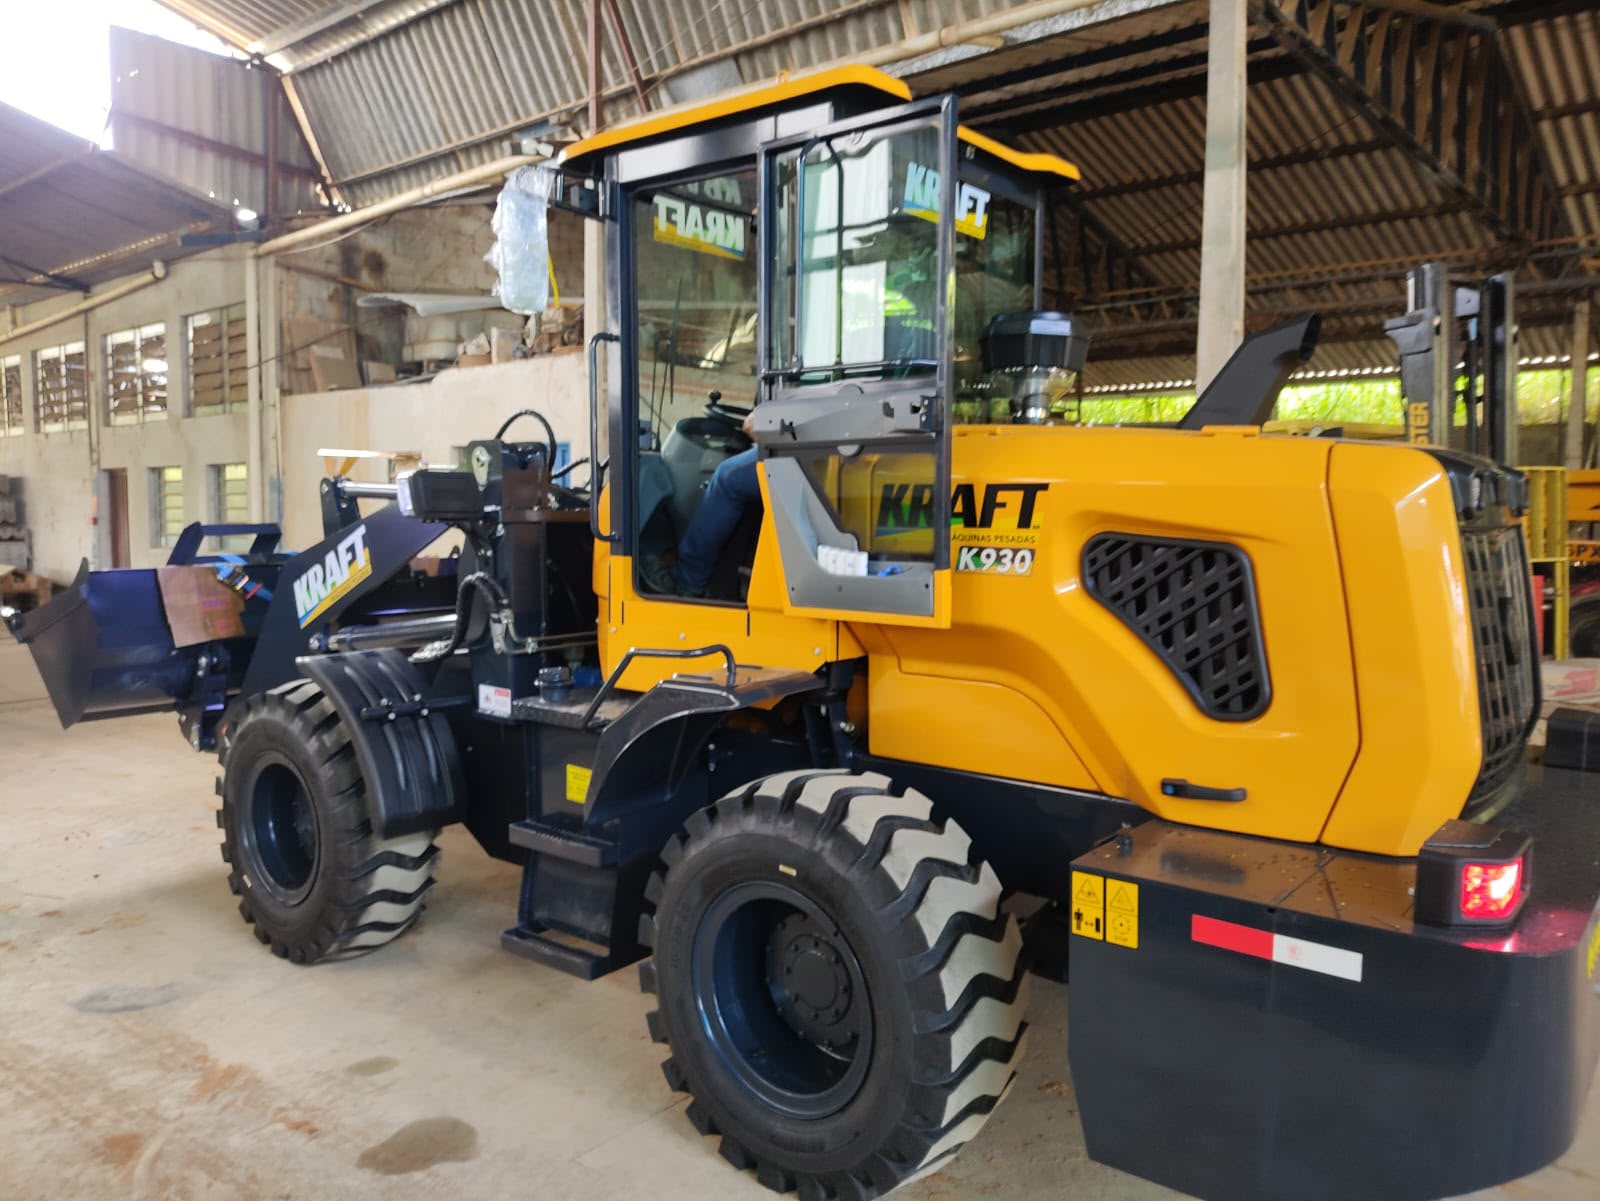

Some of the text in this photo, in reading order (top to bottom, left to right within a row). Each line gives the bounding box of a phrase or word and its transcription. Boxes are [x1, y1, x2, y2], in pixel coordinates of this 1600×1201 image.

[904, 161, 992, 229] KRFT
[1409, 402, 1429, 446] STER
[293, 524, 366, 618] KRAFT
[958, 547, 1032, 574] K930
